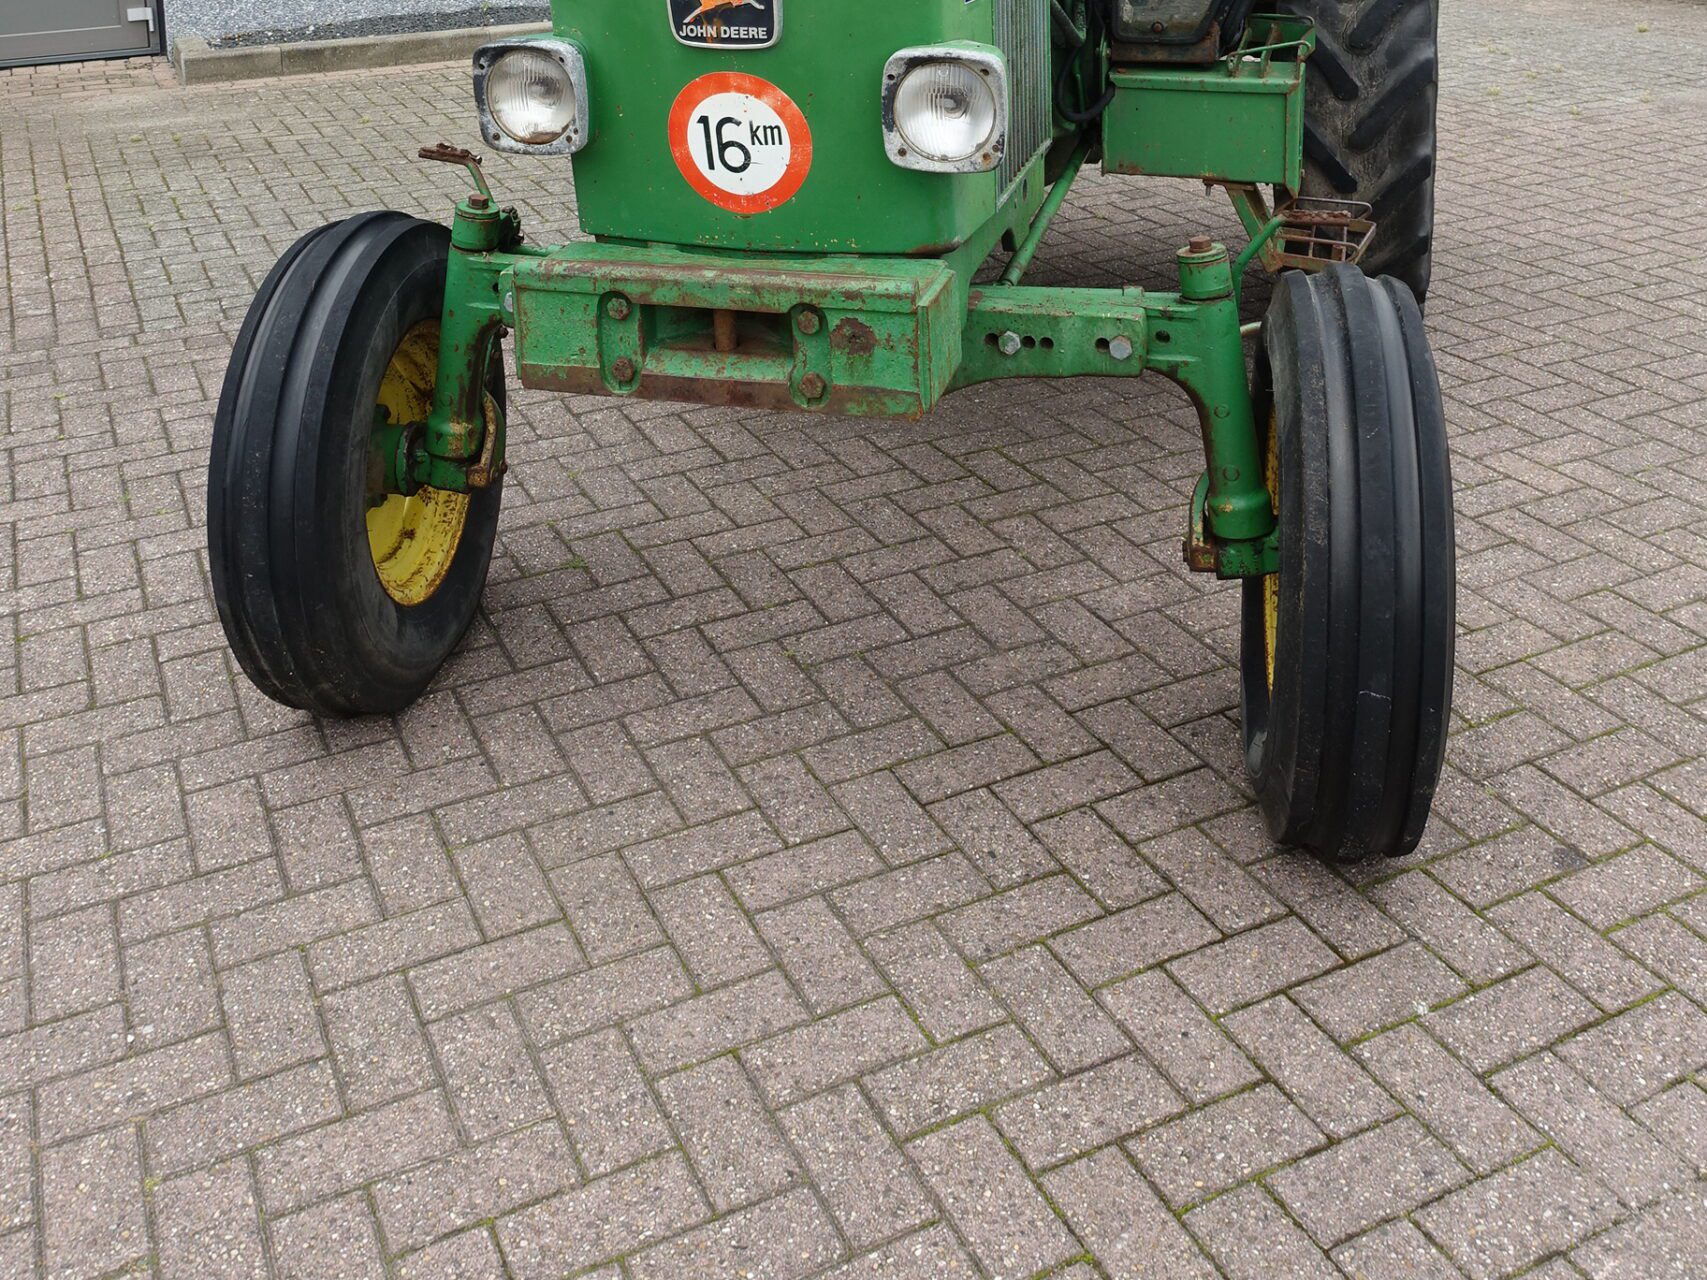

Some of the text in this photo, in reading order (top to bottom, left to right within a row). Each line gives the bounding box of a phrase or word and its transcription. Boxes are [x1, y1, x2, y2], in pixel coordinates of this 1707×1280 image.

[679, 24, 768, 40] JOHN DEERE
[697, 115, 783, 174] 16 km
